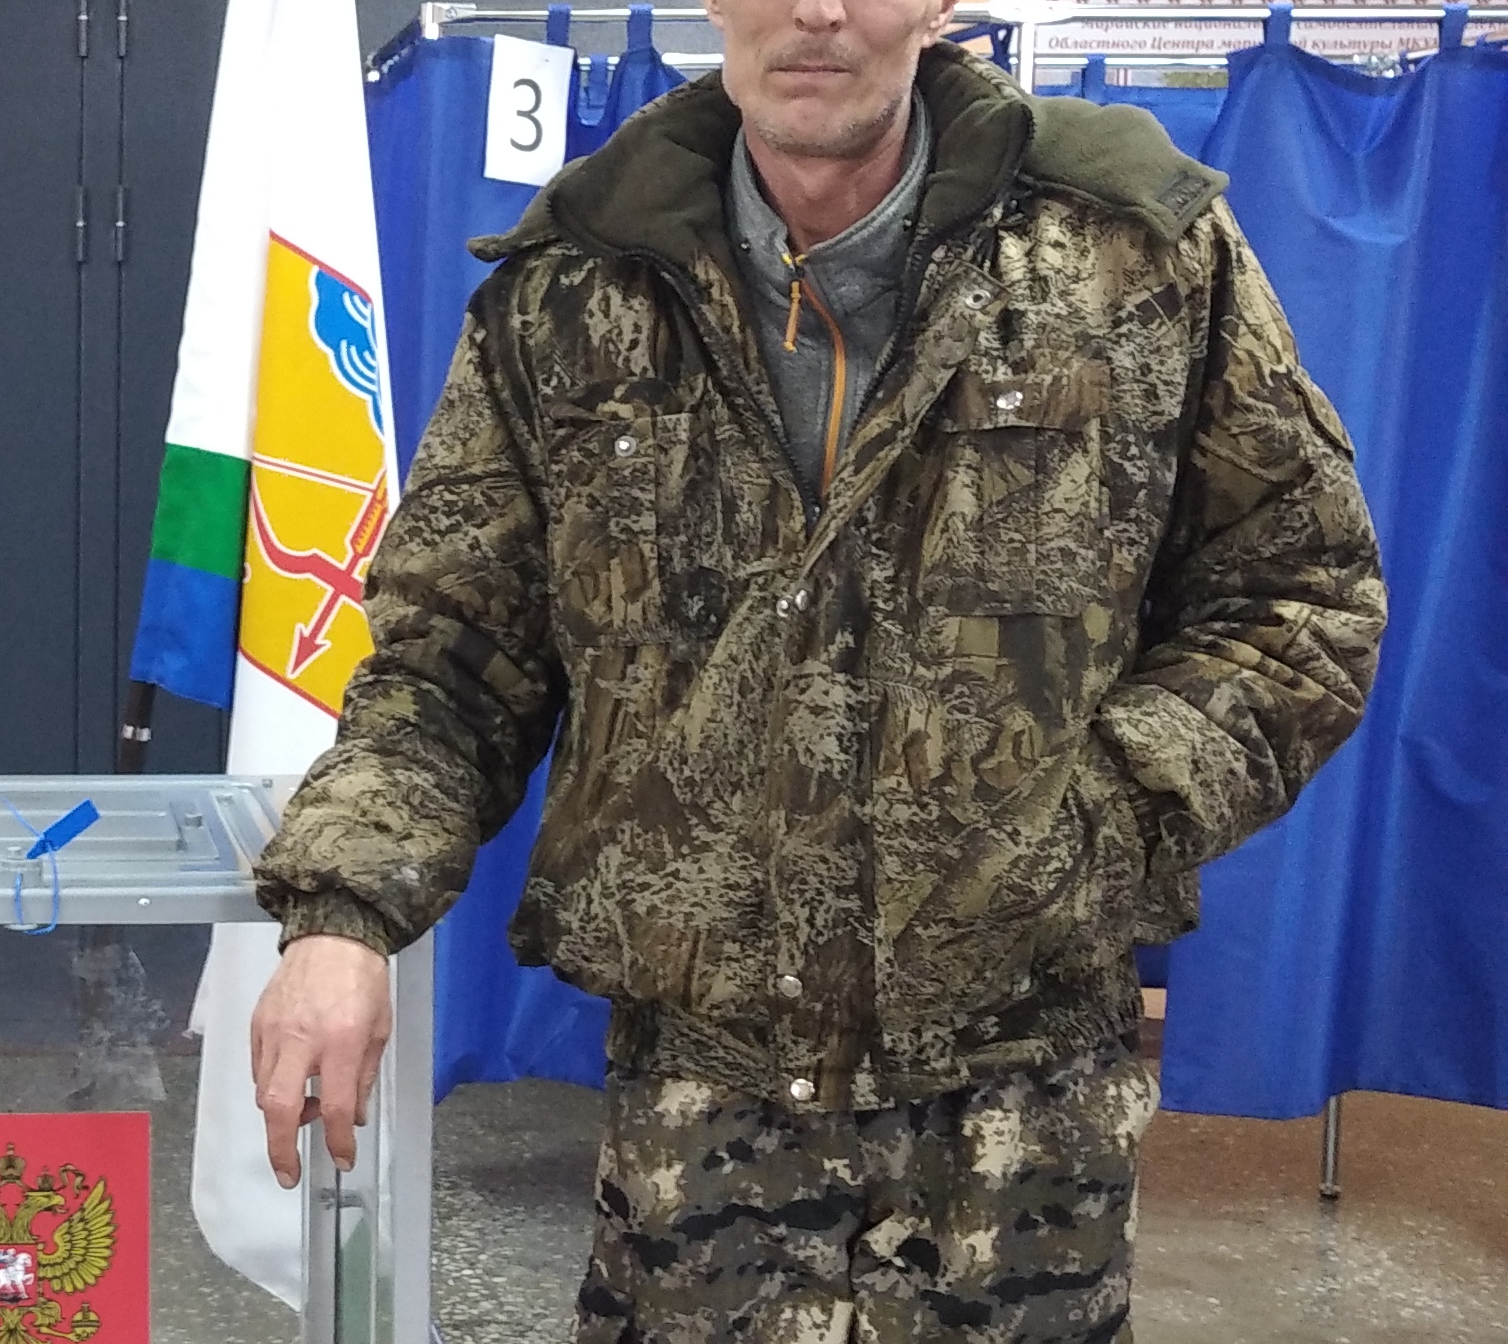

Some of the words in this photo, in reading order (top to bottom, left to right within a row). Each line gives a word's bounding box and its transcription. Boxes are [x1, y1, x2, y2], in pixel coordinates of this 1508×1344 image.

[1048, 36, 1147, 50] Областного
[1151, 36, 1218, 53] Центра
[509, 78, 543, 152] 3
